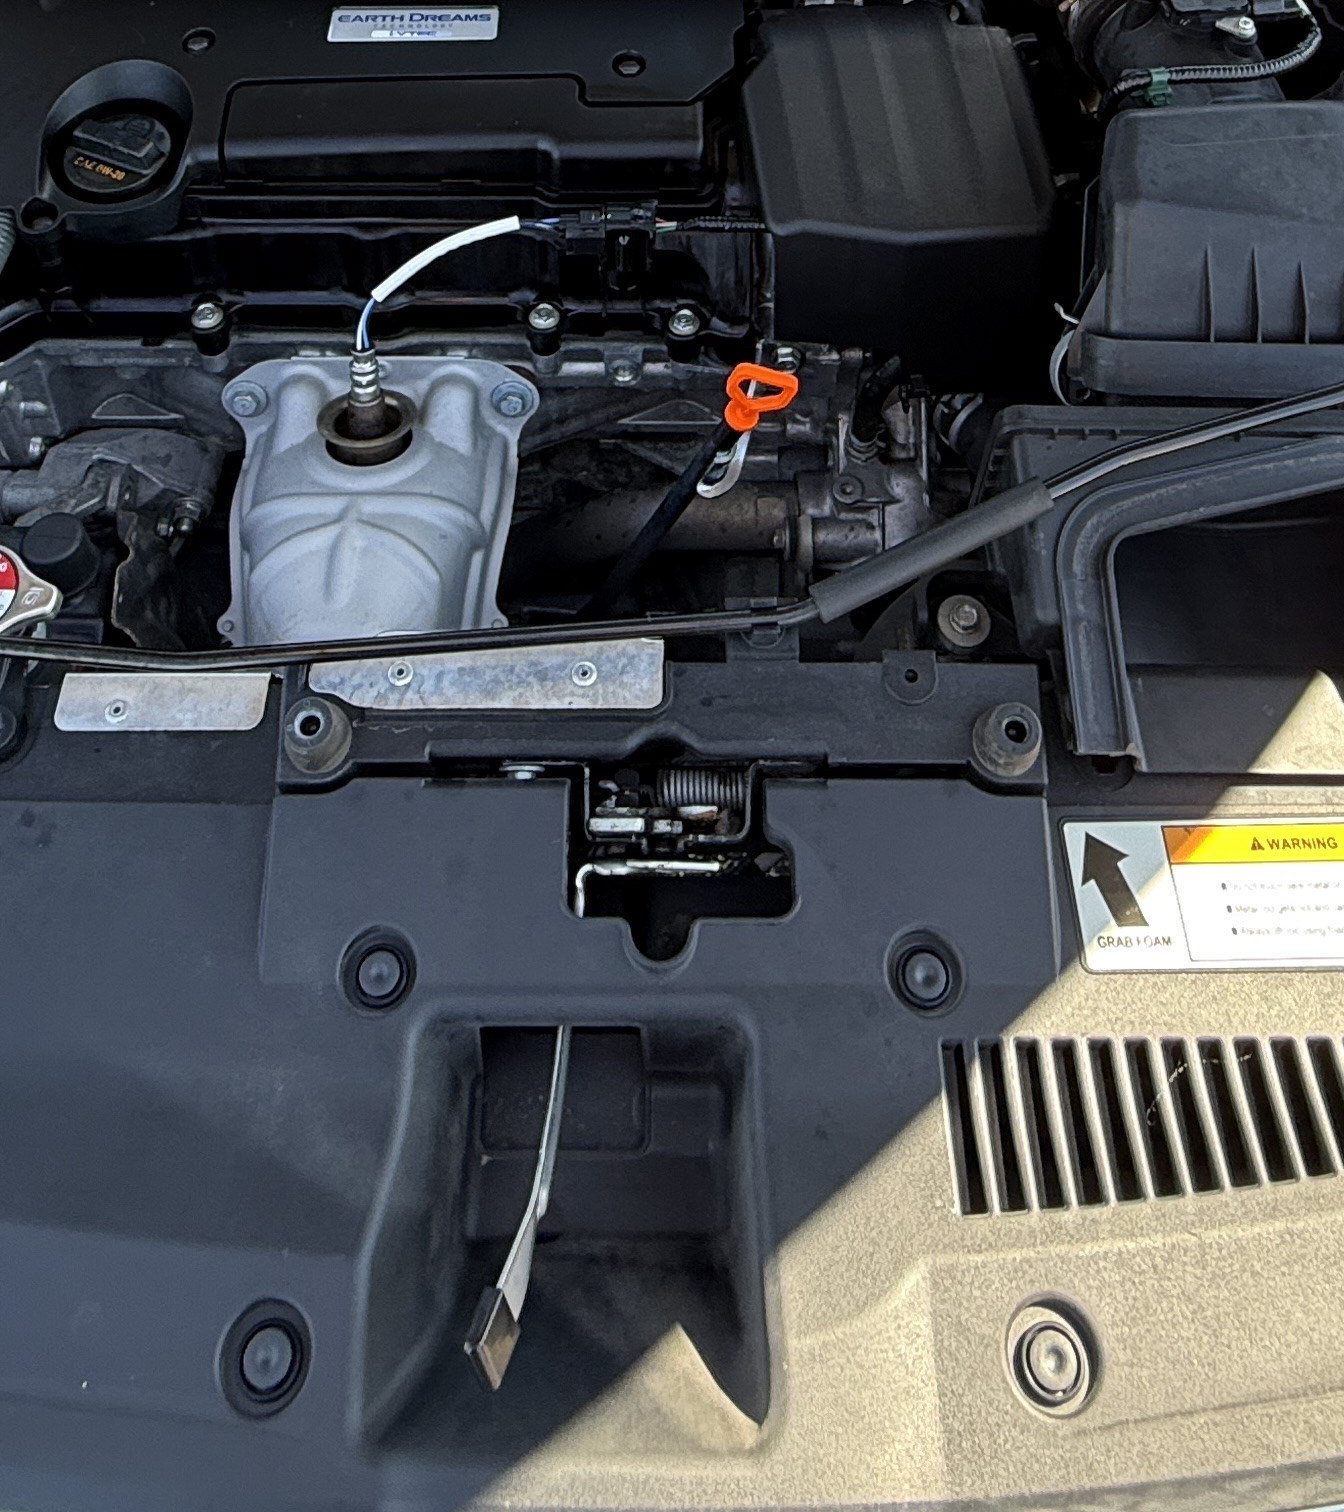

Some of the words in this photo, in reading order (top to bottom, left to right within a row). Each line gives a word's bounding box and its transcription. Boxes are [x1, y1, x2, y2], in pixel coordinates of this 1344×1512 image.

[337, 14, 405, 23] EARTH
[409, 13, 492, 23] DREAMS
[1267, 836, 1339, 851] WARNING
[1097, 935, 1133, 948] GRAB
